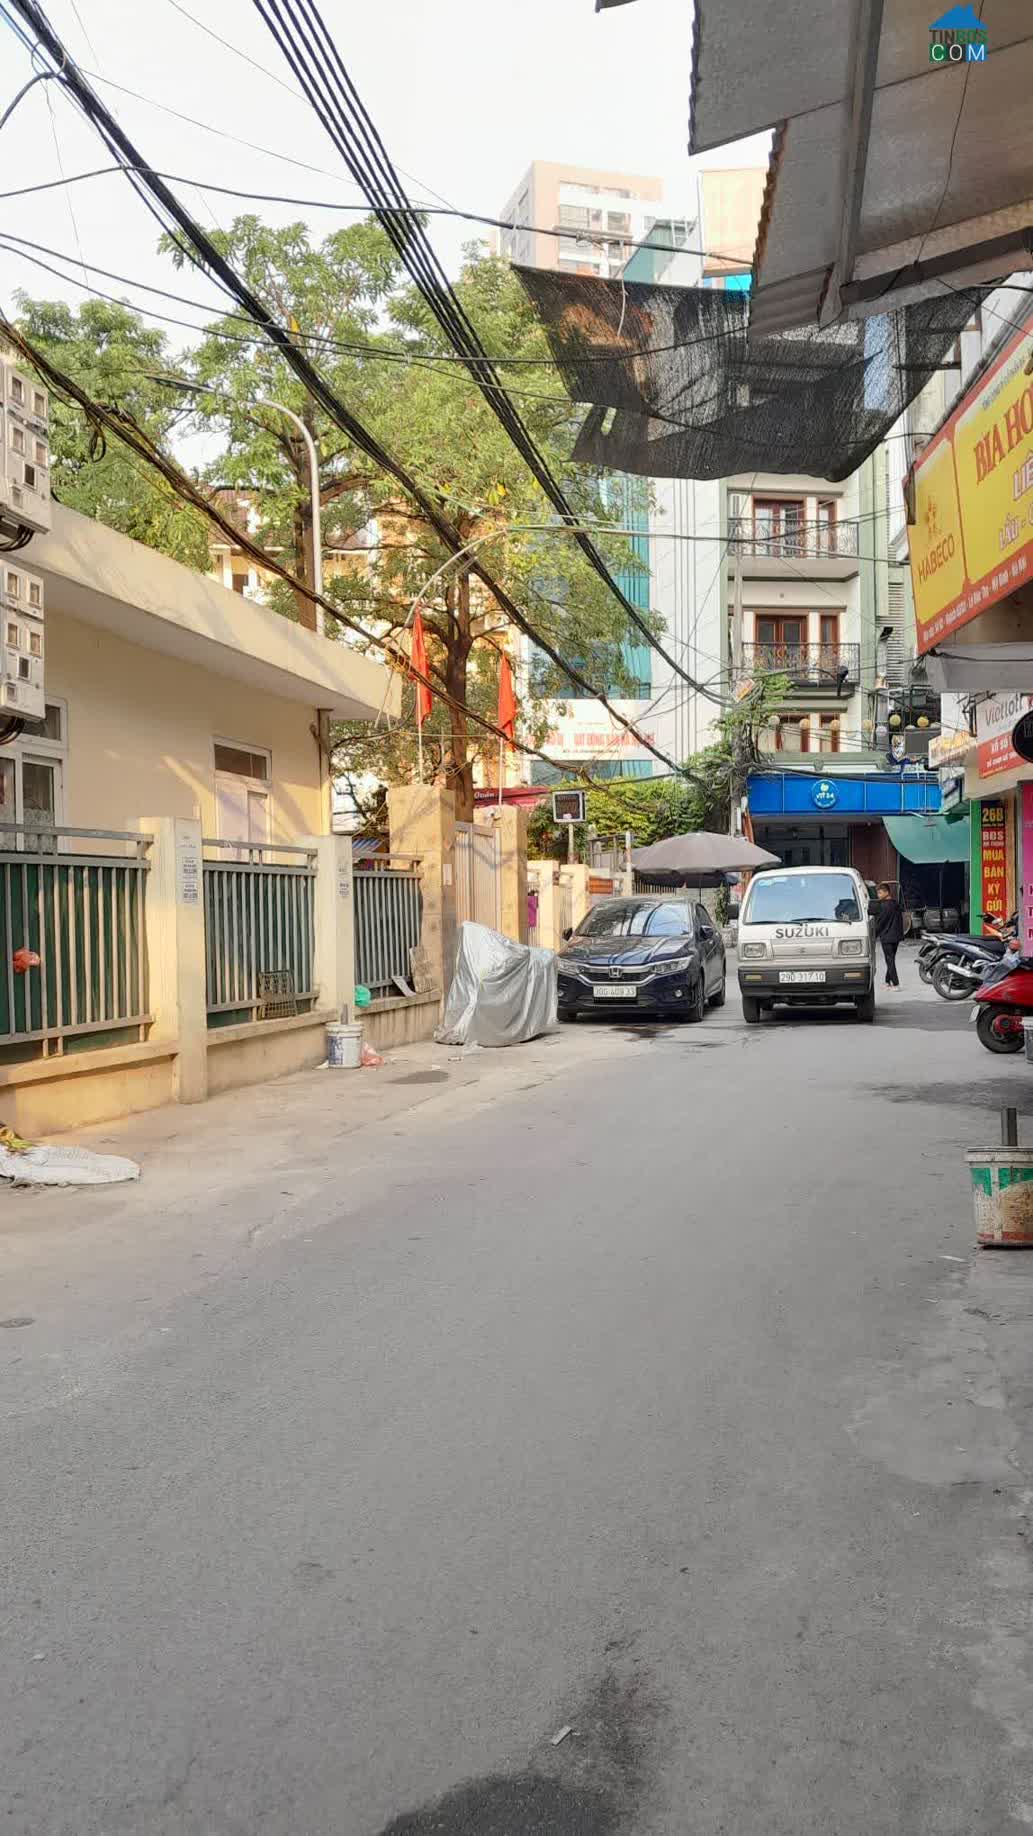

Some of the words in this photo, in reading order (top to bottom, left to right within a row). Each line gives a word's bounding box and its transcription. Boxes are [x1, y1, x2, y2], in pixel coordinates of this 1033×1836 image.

[974, 424, 1006, 486] BIA
[917, 533, 955, 585] HABECO
[983, 849, 1005, 861] MUA
[775, 926, 830, 939] SUZUKI
